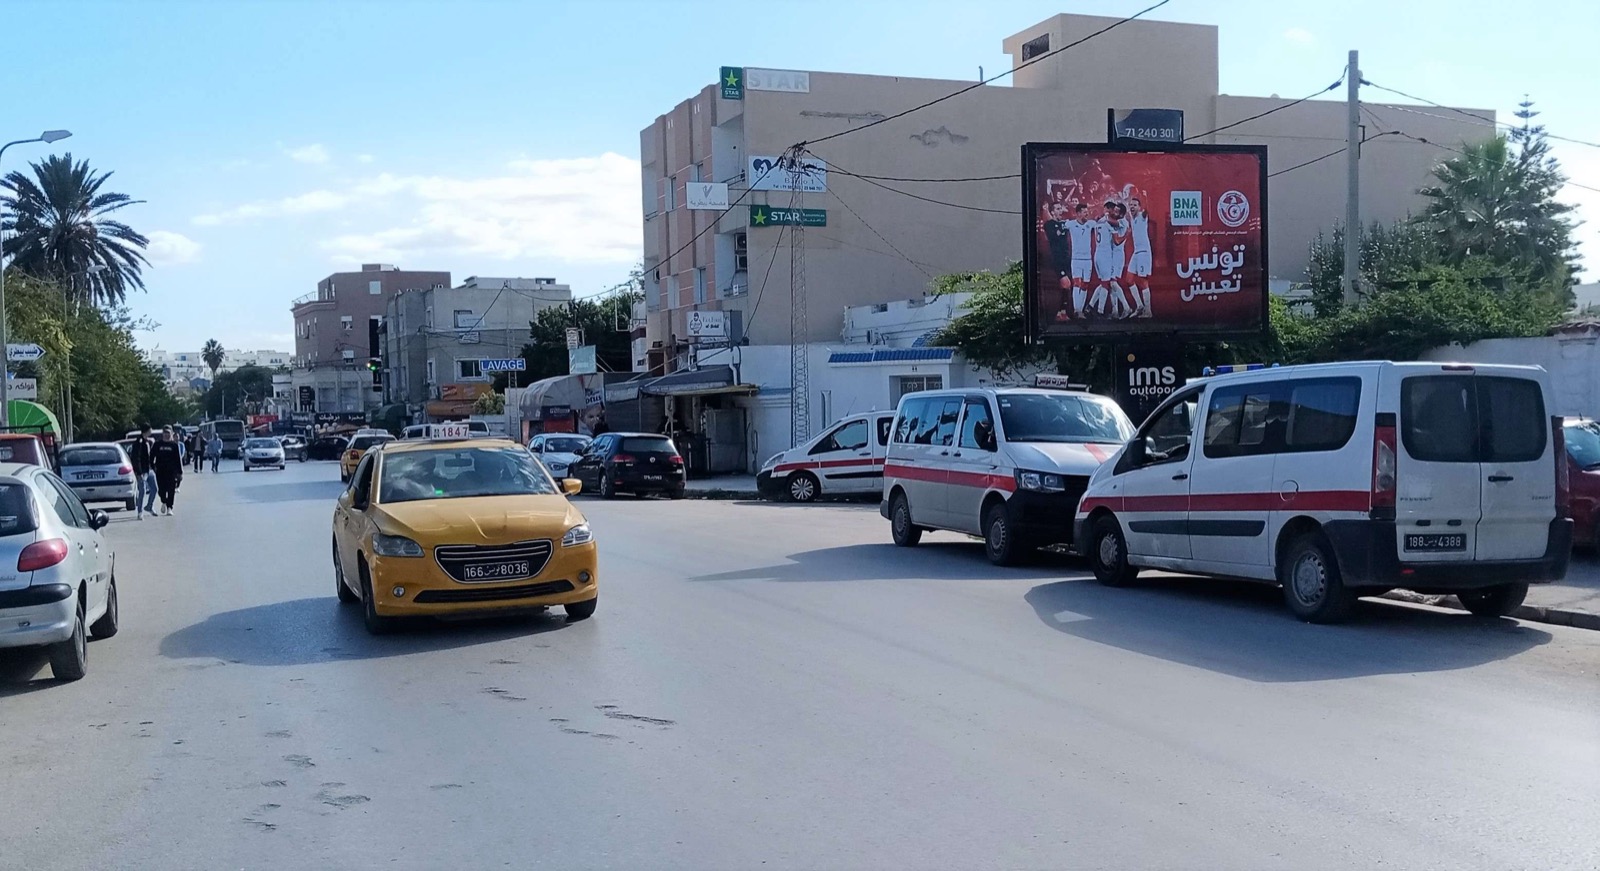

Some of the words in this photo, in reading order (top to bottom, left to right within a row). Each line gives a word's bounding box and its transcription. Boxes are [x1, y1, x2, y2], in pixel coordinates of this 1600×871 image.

[748, 71, 808, 90] STAR
[1125, 128, 1136, 138] 71
[1138, 128, 1158, 138] 240
[1160, 128, 1174, 138] 301
[1173, 198, 1198, 209] BNA
[770, 211, 800, 221] STAR
[1174, 210, 1199, 219] BANK
[1176, 244, 1246, 279] تونس
[1180, 272, 1242, 302] تعيش
[481, 360, 523, 370] LAVAGE
[1129, 366, 1176, 386] ims
[1130, 385, 1176, 396] outdoor
[442, 427, 469, 437] 1847
[1409, 536, 1424, 547] 188
[1438, 536, 1461, 547] 4388
[466, 566, 484, 578] 166
[501, 562, 528, 575] 8036
